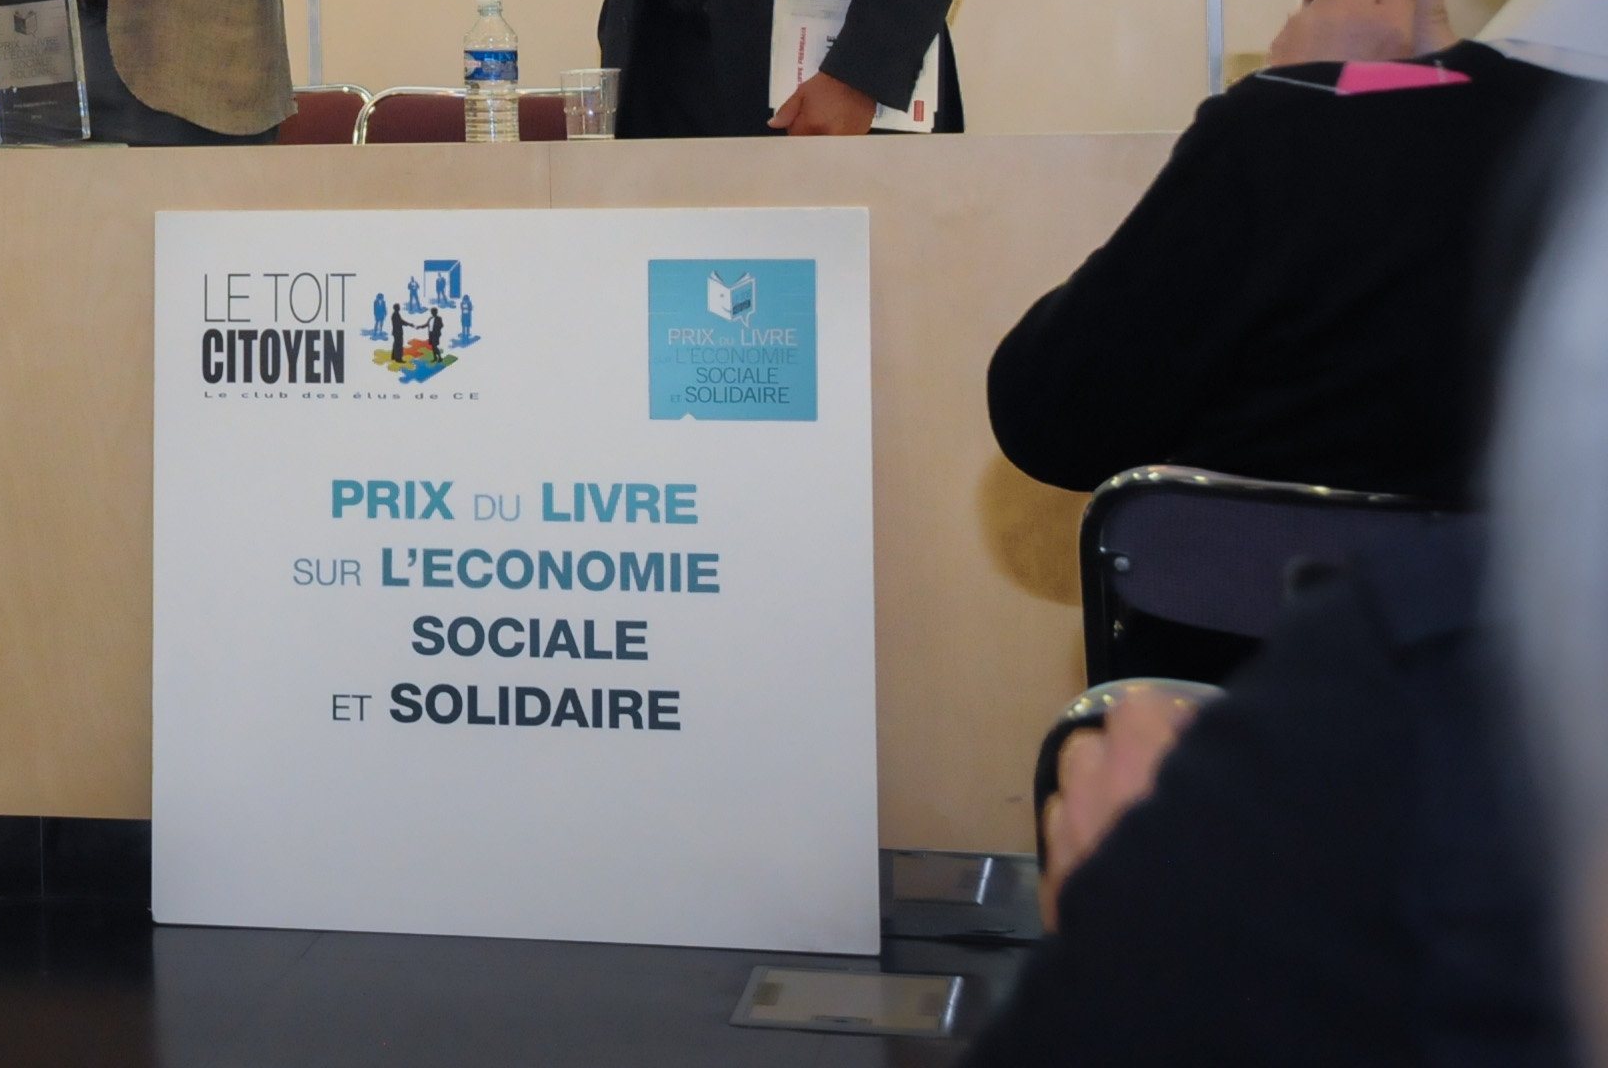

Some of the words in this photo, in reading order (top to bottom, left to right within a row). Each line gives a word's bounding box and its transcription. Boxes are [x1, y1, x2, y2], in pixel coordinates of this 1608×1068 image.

[204, 273, 251, 322] LE
[263, 272, 357, 323] TOIT
[202, 328, 345, 384] CITOYEN
[668, 328, 714, 346] PRIX
[740, 329, 798, 346] LIVRE
[676, 347, 798, 365] L'ECONOMIE
[204, 391, 227, 400] Le
[241, 390, 288, 400] club
[302, 390, 339, 400] des
[353, 390, 400, 400] élus
[415, 391, 439, 400] de
[453, 391, 480, 401] CE
[670, 394, 681, 403] ET
[685, 386, 790, 404] SOLIDAIRE
[696, 367, 779, 384] SOCIALE
[331, 480, 455, 520] PRIX
[474, 494, 521, 521] DU
[542, 483, 698, 524] LIVRE
[293, 558, 361, 586] SUR
[382, 548, 720, 593] L'ECONOMIE
[411, 615, 648, 661] SOCIALE
[332, 695, 371, 721] ET
[389, 683, 681, 731] SOLIDAIRE
